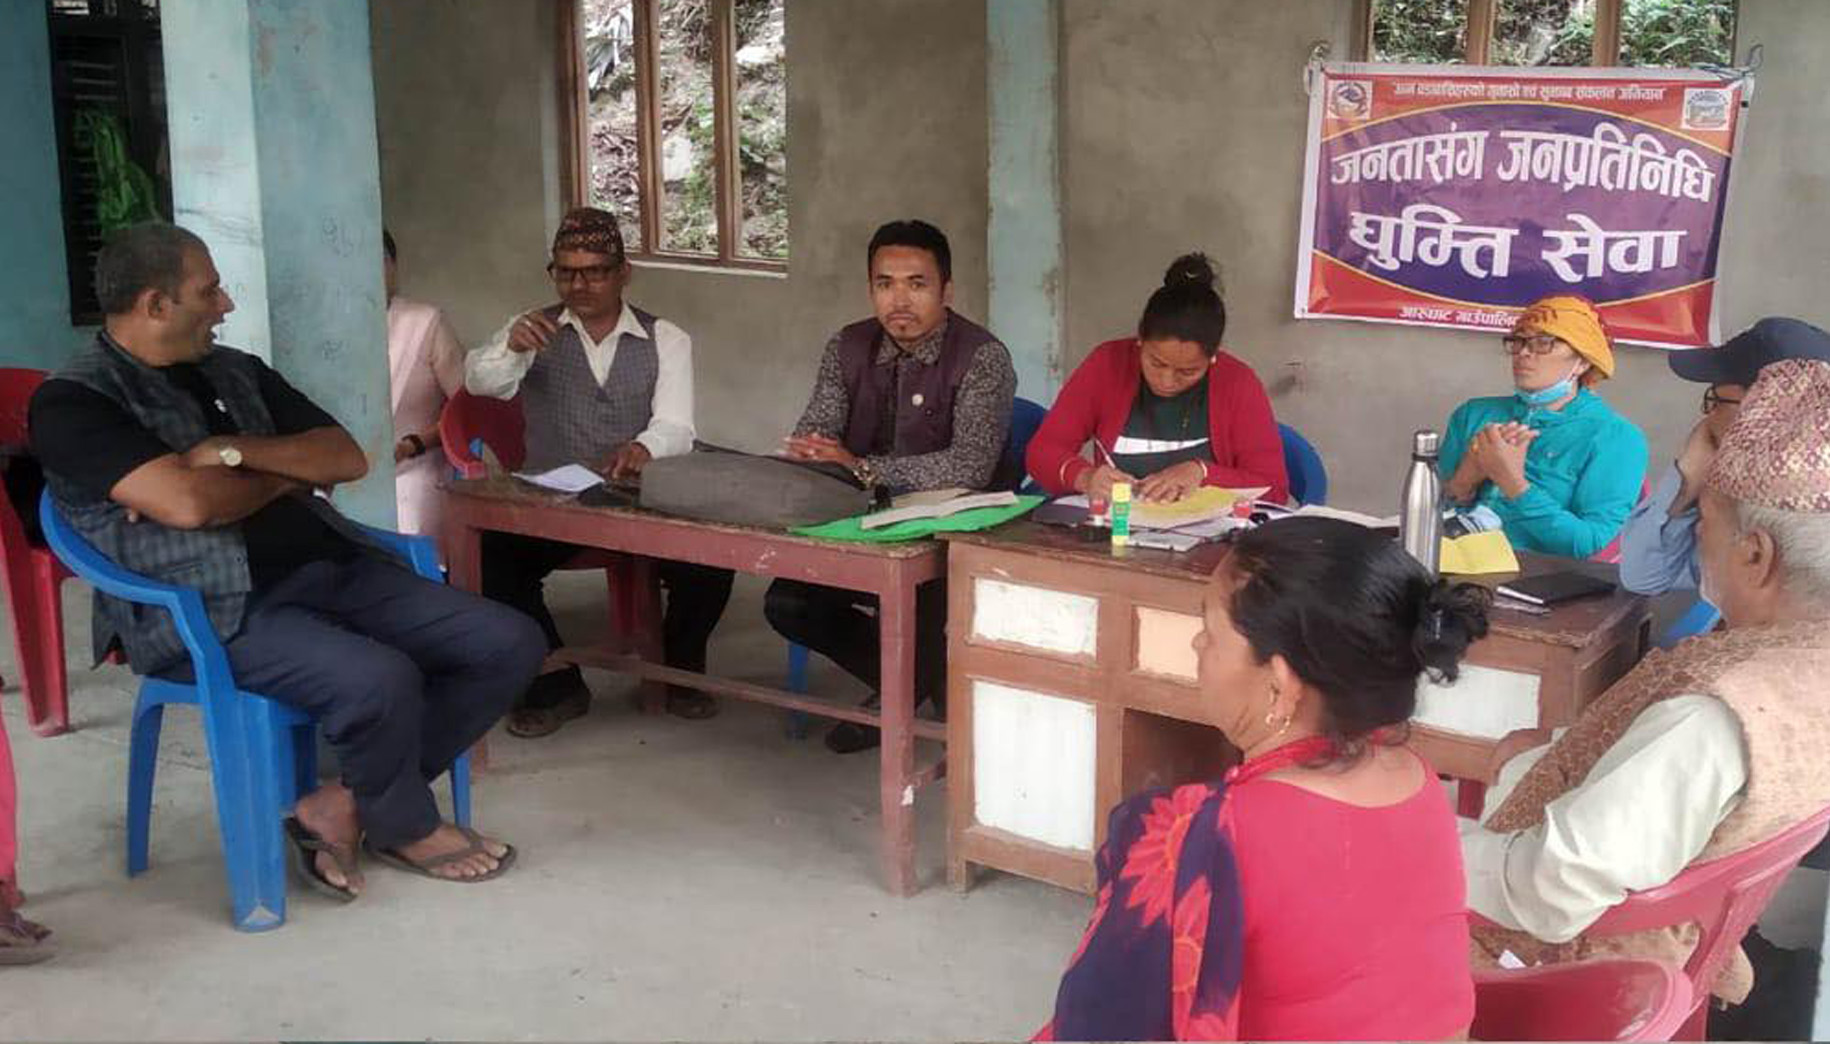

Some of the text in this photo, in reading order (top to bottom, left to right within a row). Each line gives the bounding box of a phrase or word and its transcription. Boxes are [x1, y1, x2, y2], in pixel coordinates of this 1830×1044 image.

[1331, 121, 1715, 202] जनतासंग जनप्रतिनिधि
[1349, 204, 1687, 283] घुम्ति सेवा
